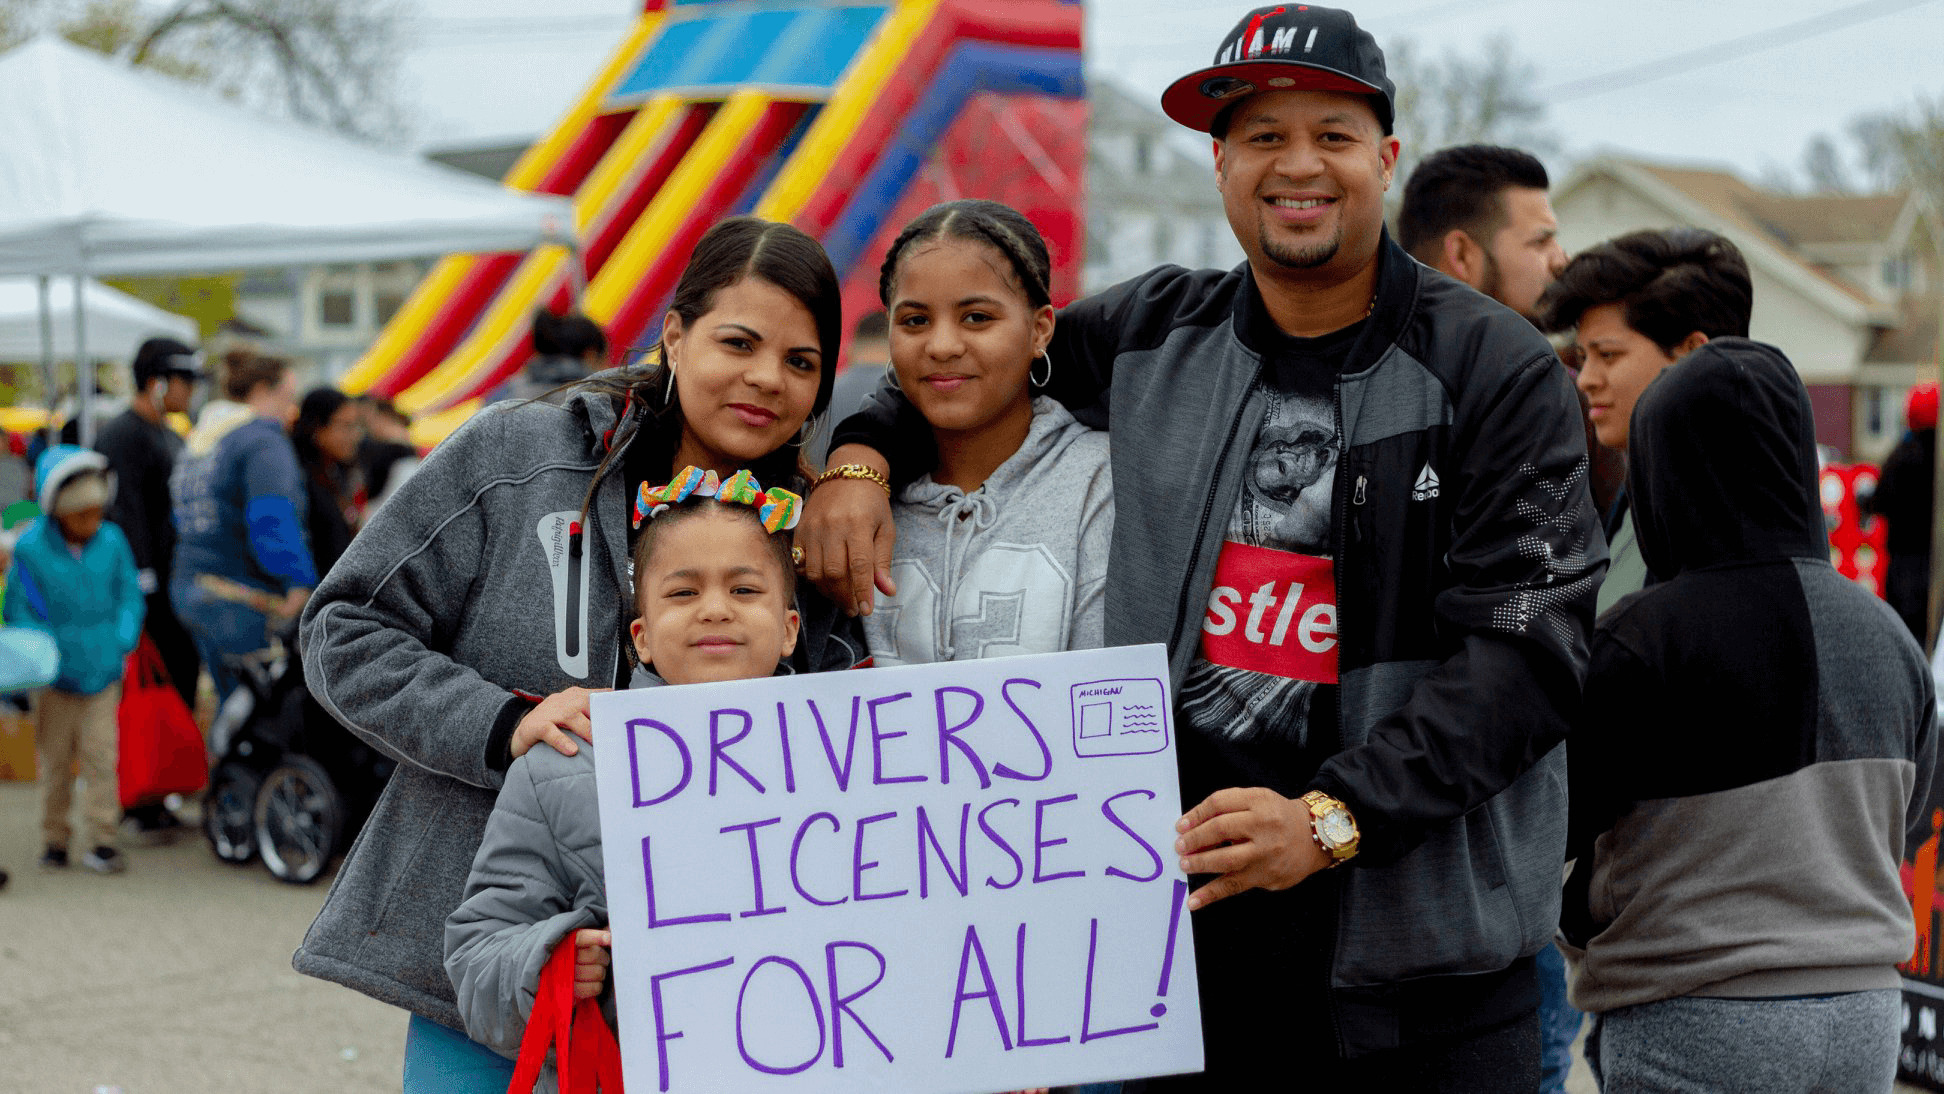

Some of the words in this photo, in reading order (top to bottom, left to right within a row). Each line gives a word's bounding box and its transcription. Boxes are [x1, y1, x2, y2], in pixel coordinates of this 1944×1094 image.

[1412, 489, 1440, 501] Rebo
[625, 678, 1053, 808] DRIVERS
[1080, 686, 1123, 698] MICHIGAN
[641, 789, 1164, 929] LICENSES
[650, 940, 894, 1093] FOR
[945, 879, 1188, 1059] ALL!
